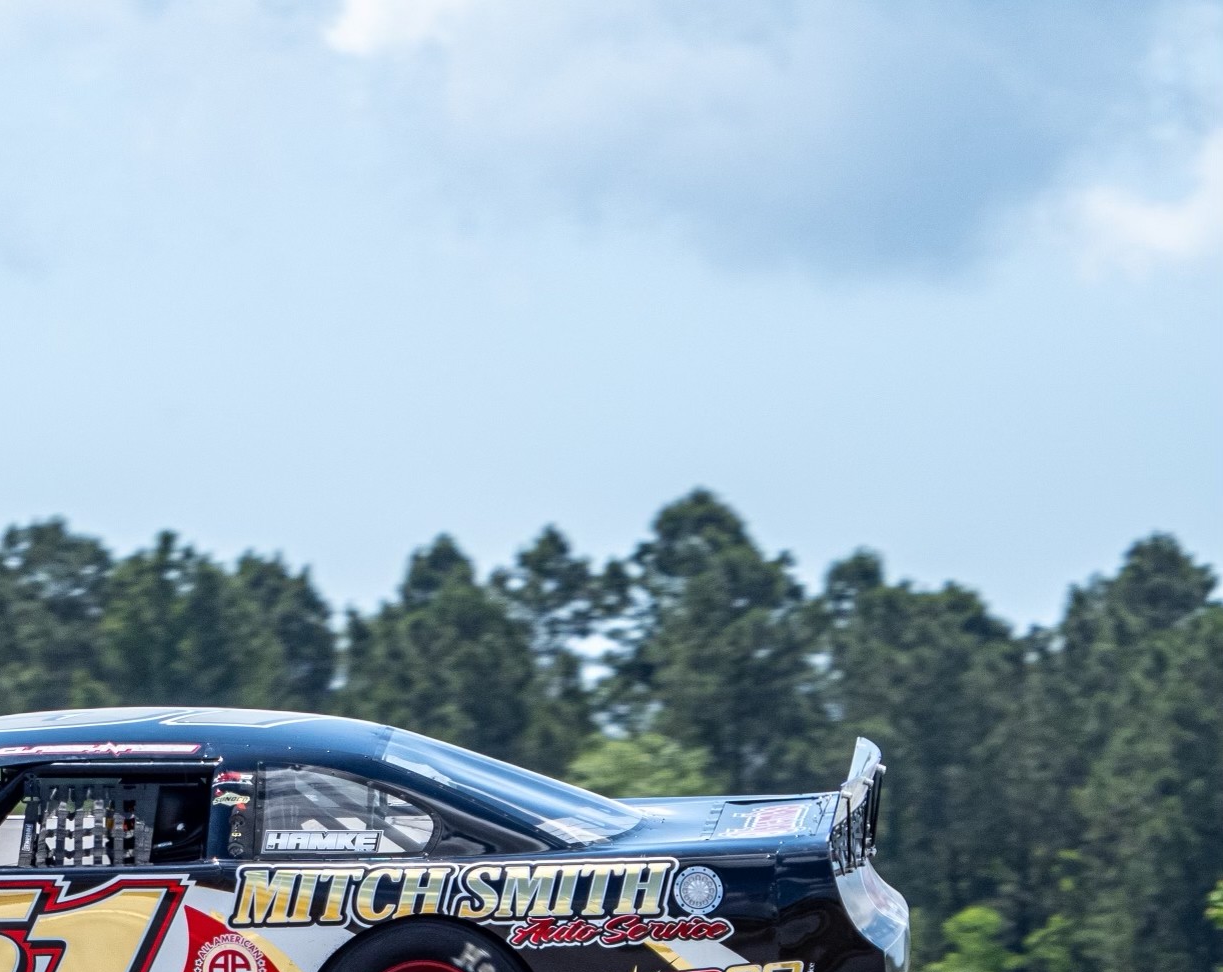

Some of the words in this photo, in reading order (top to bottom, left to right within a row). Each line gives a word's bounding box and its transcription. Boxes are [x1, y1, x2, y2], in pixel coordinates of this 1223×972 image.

[266, 831, 378, 851] HAMKE
[232, 868, 451, 924] MITCH
[459, 862, 671, 918] SMITH
[511, 916, 603, 946] Auto
[600, 914, 731, 944] Service
[198, 941, 215, 959] ALL
[213, 934, 263, 959] AMERICAN
